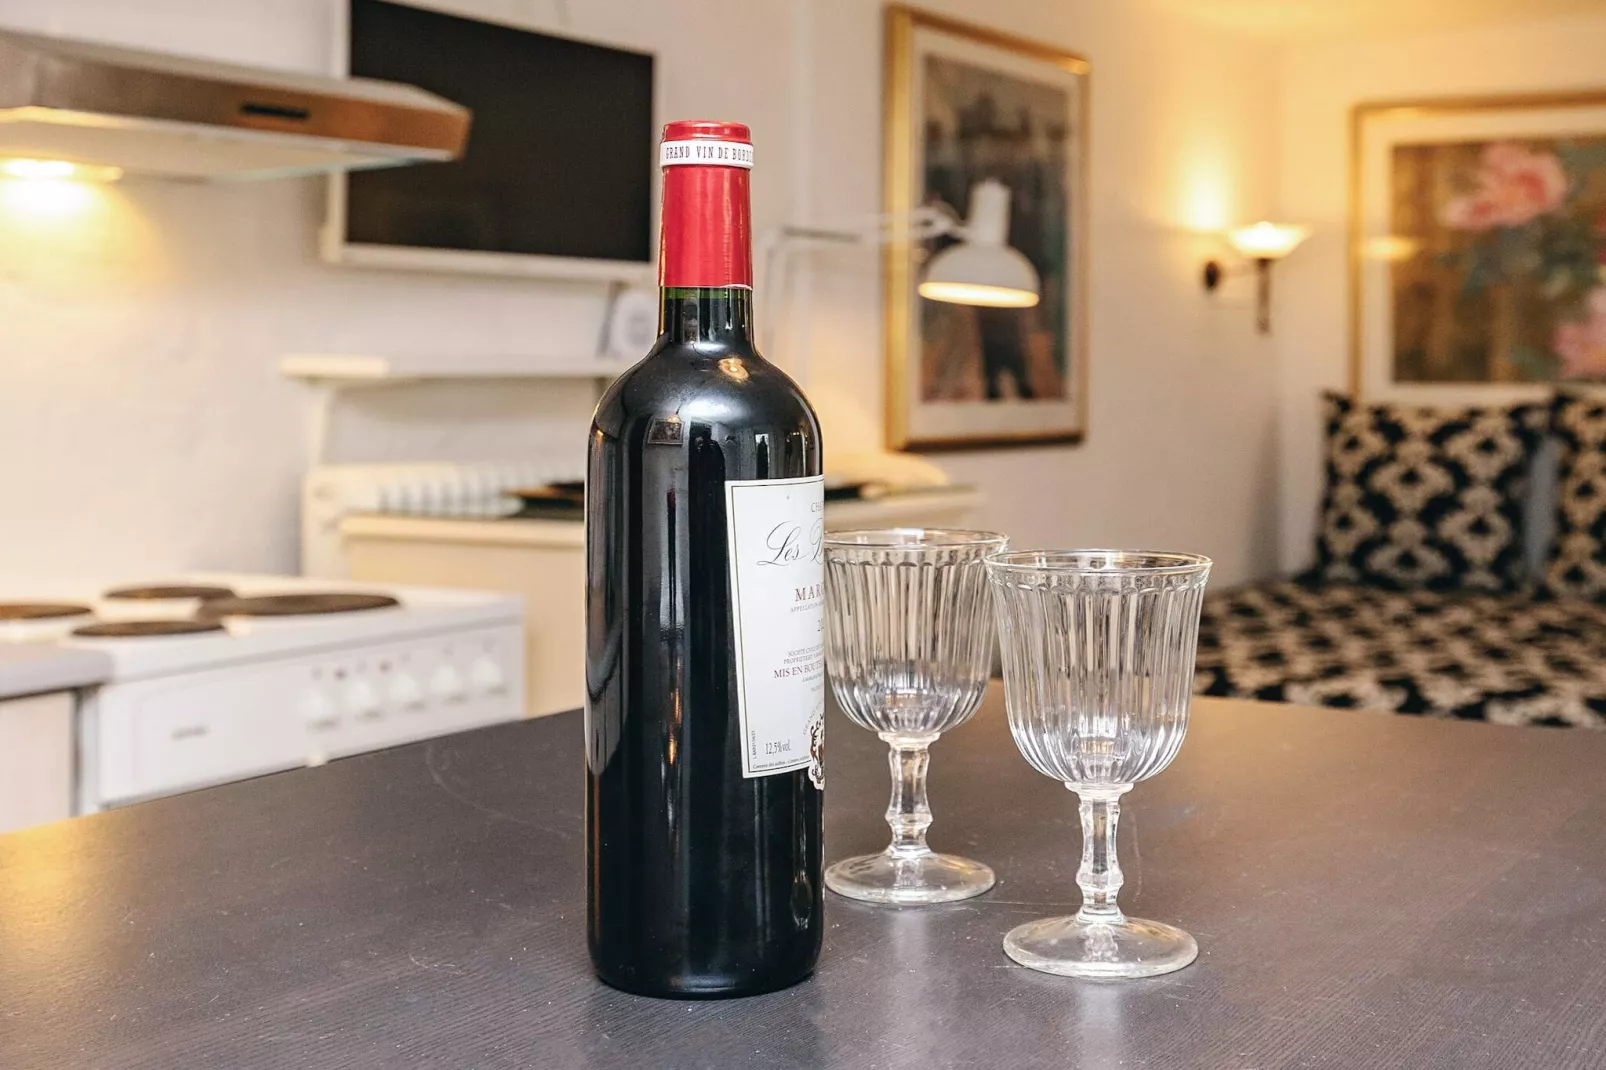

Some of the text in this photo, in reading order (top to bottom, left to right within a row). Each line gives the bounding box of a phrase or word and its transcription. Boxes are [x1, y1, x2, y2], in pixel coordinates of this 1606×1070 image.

[666, 145, 690, 160] GRAND
[697, 145, 714, 159] VIN
[718, 146, 729, 160] DE
[756, 520, 809, 567] Les
[773, 667, 791, 679] MIS
[792, 665, 803, 676] EN
